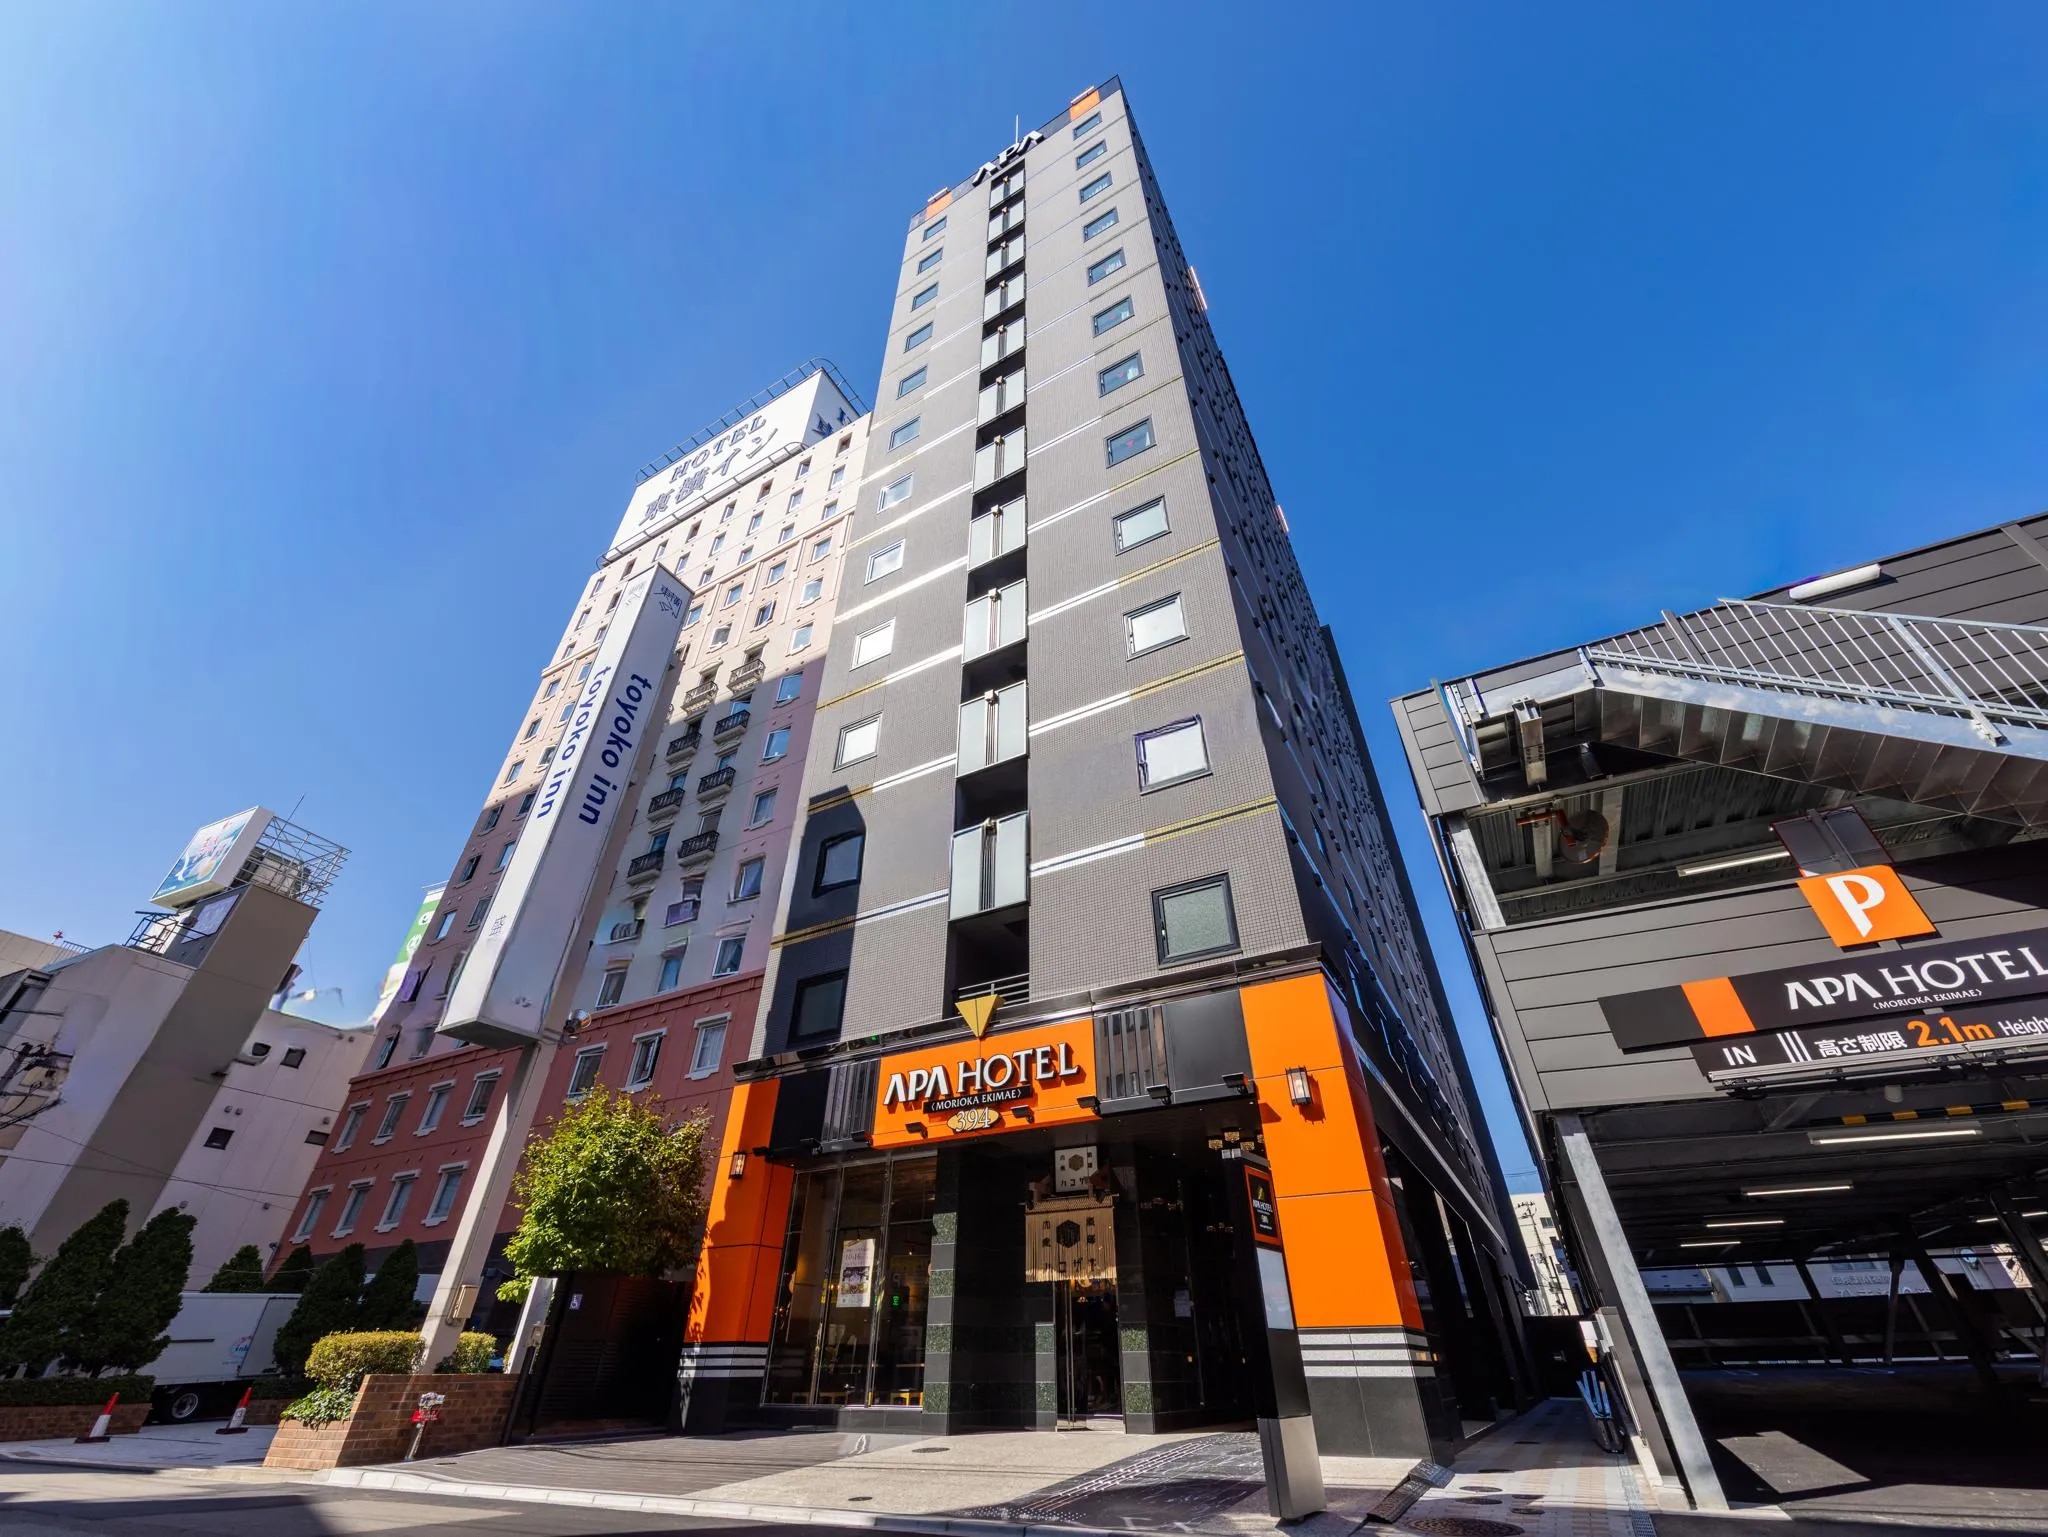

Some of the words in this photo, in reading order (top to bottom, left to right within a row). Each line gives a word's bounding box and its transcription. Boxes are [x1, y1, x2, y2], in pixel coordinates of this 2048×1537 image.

[972, 130, 1045, 187] APA
[669, 415, 767, 484] HOTEL
[561, 665, 612, 761] toyoko
[601, 673, 653, 769] toyoko
[536, 766, 571, 819] inn
[578, 773, 618, 826] inn
[1825, 873, 1886, 938] P
[1784, 973, 1884, 1011] APA
[1878, 946, 2048, 996] HOTEL
[1722, 1045, 1757, 1066] IN
[1814, 1030, 1908, 1058] 高さ制限
[1906, 1016, 1996, 1047] 2.1m
[883, 1065, 949, 1105] APA
[956, 1042, 1079, 1093] HOTEL
[955, 1107, 992, 1133] 394
